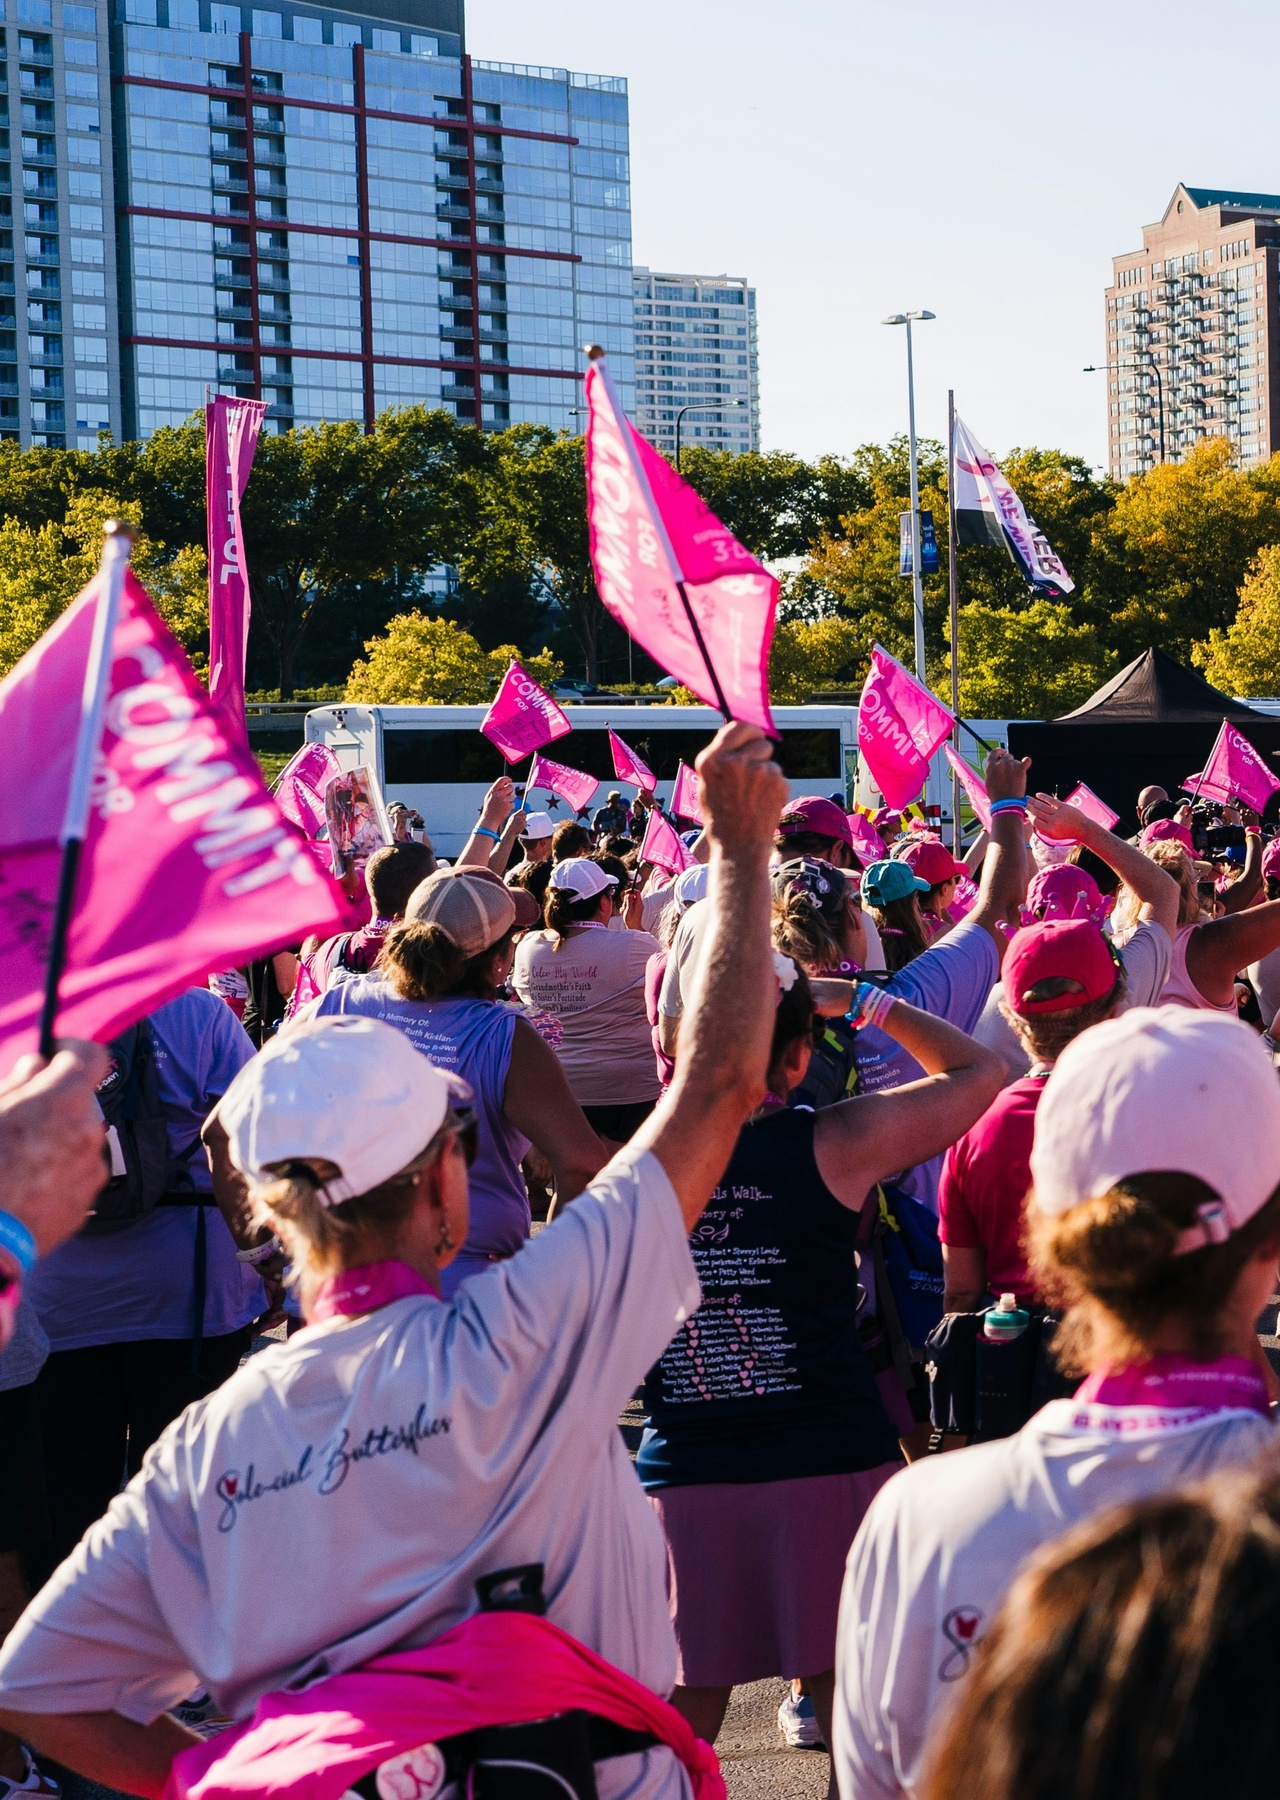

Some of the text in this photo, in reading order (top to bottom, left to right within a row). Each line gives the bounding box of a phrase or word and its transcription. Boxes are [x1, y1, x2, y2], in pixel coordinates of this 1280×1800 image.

[510, 672, 565, 727] COMMIT
[513, 697, 529, 712] FOR
[547, 761, 595, 784] COMMIT
[530, 983, 592, 991] Grandmother's Faith
[557, 993, 586, 1001] Fortitude
[385, 1013, 417, 1025] Memory
[404, 1027, 423, 1036] Ruth
[862, 1062, 888, 1075] Brown
[865, 1068, 901, 1086] Reynolds
